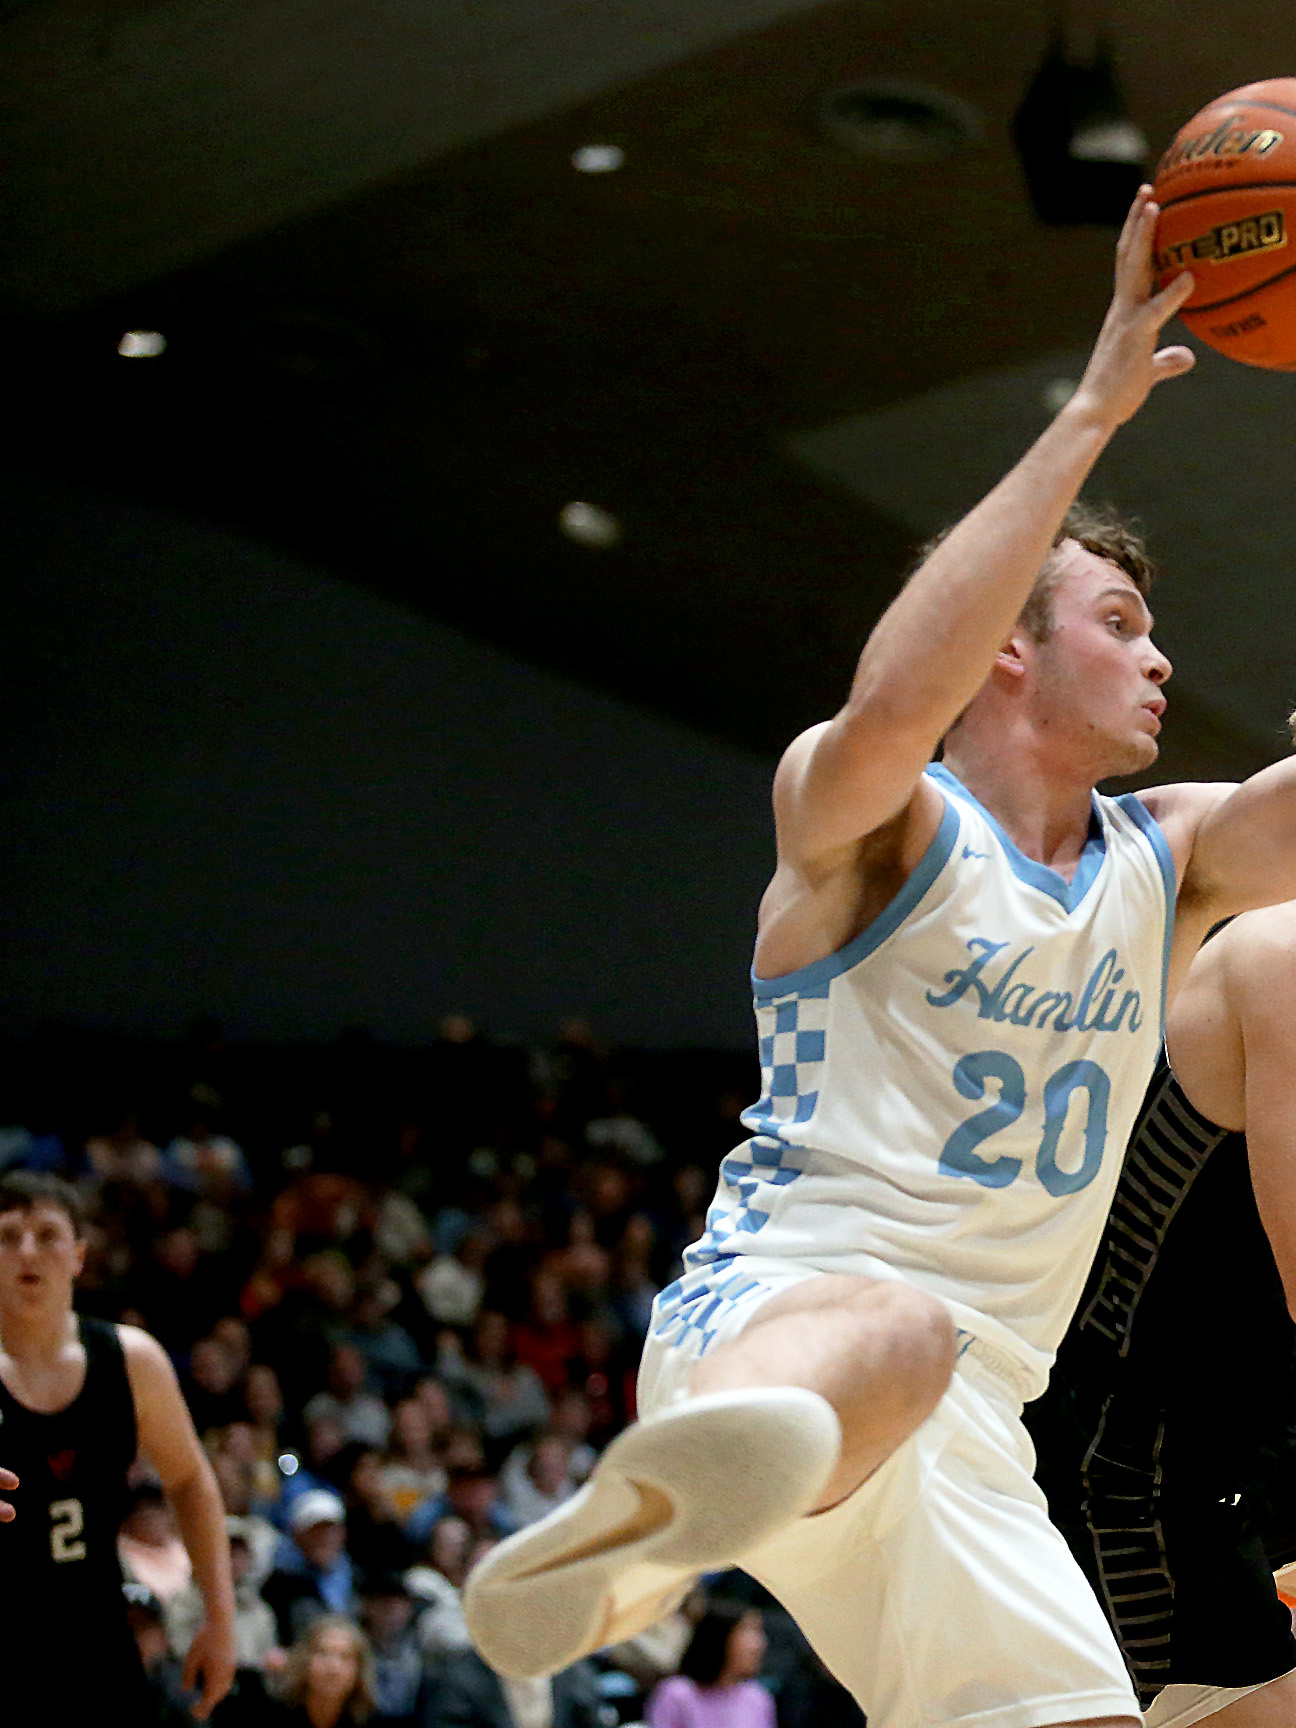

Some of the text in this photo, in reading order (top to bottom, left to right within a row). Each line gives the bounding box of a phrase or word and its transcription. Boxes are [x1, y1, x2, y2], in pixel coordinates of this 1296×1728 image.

[1219, 213, 1283, 257] PRO
[926, 937, 1143, 1033] Hamlin
[938, 1050, 1111, 1198] 20
[49, 1498, 86, 1562] 2
